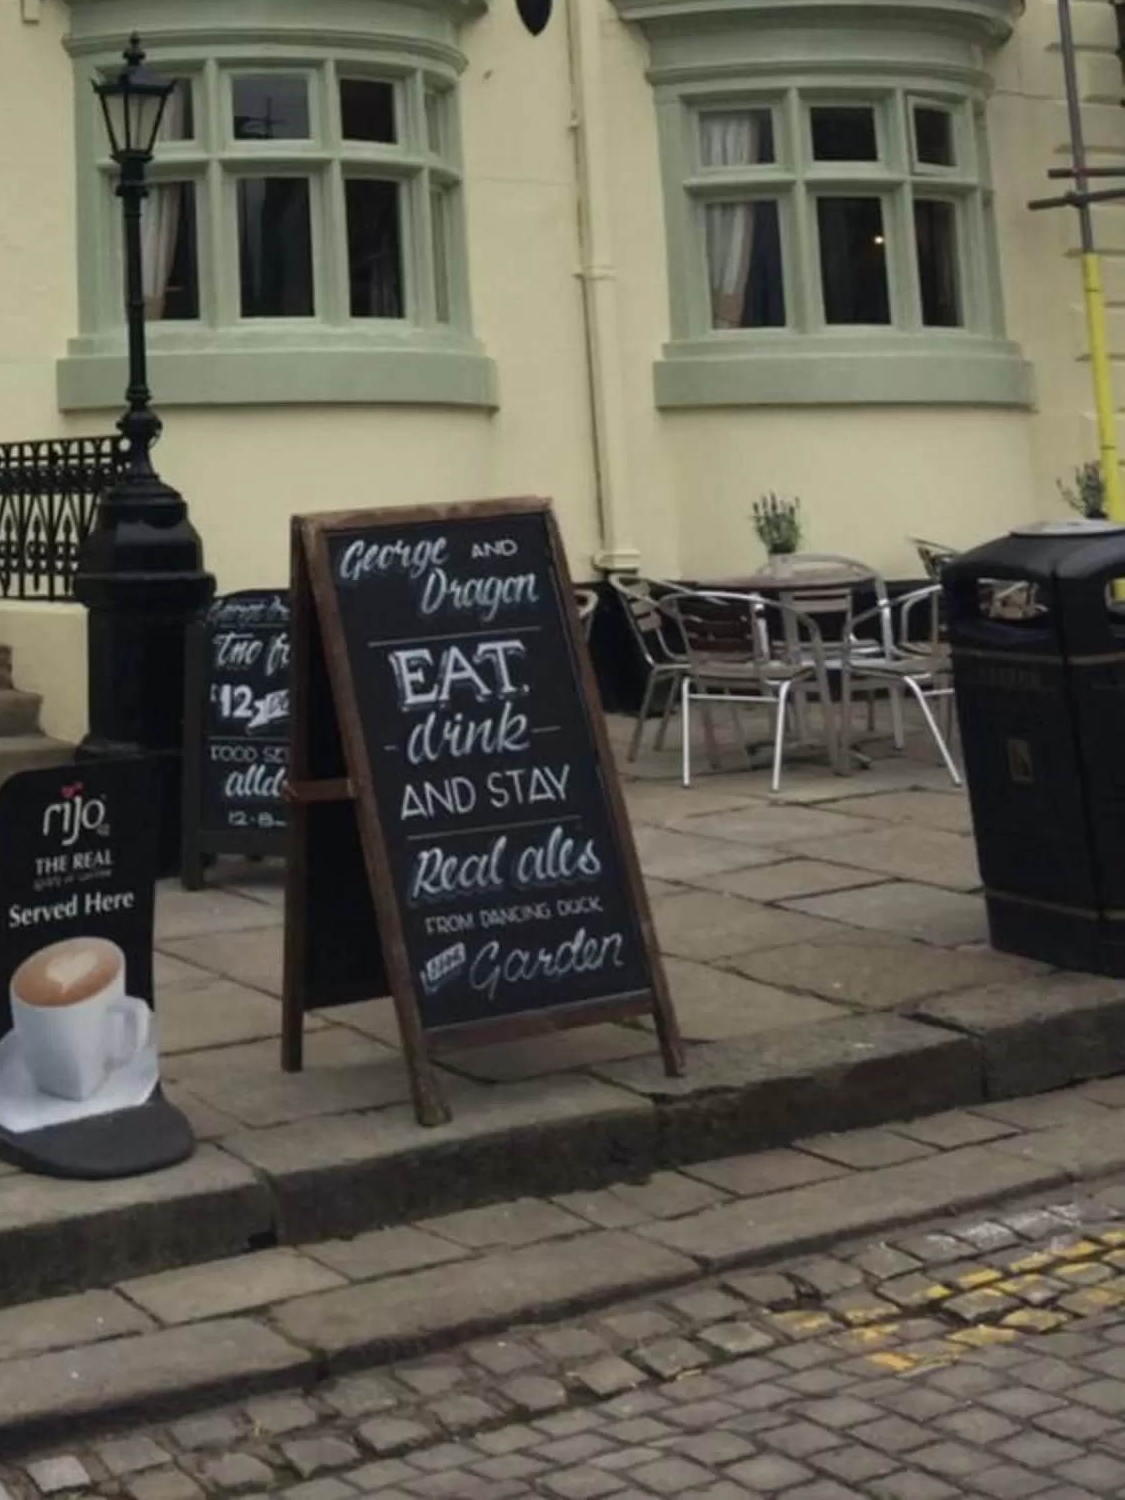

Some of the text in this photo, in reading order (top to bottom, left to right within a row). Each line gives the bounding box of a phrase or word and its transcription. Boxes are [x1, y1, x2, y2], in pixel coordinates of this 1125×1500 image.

[339, 536, 519, 581] George AND
[420, 567, 540, 623] Dragon
[210, 744, 258, 762] FOOD
[406, 701, 531, 765] drink
[400, 763, 571, 821] AND STAY
[35, 848, 113, 876] THE REAL
[411, 825, 603, 900] Real ales
[8, 891, 135, 929] Served Here
[425, 896, 604, 934] FROM DANCING DUCK
[469, 927, 625, 1001] Garden
